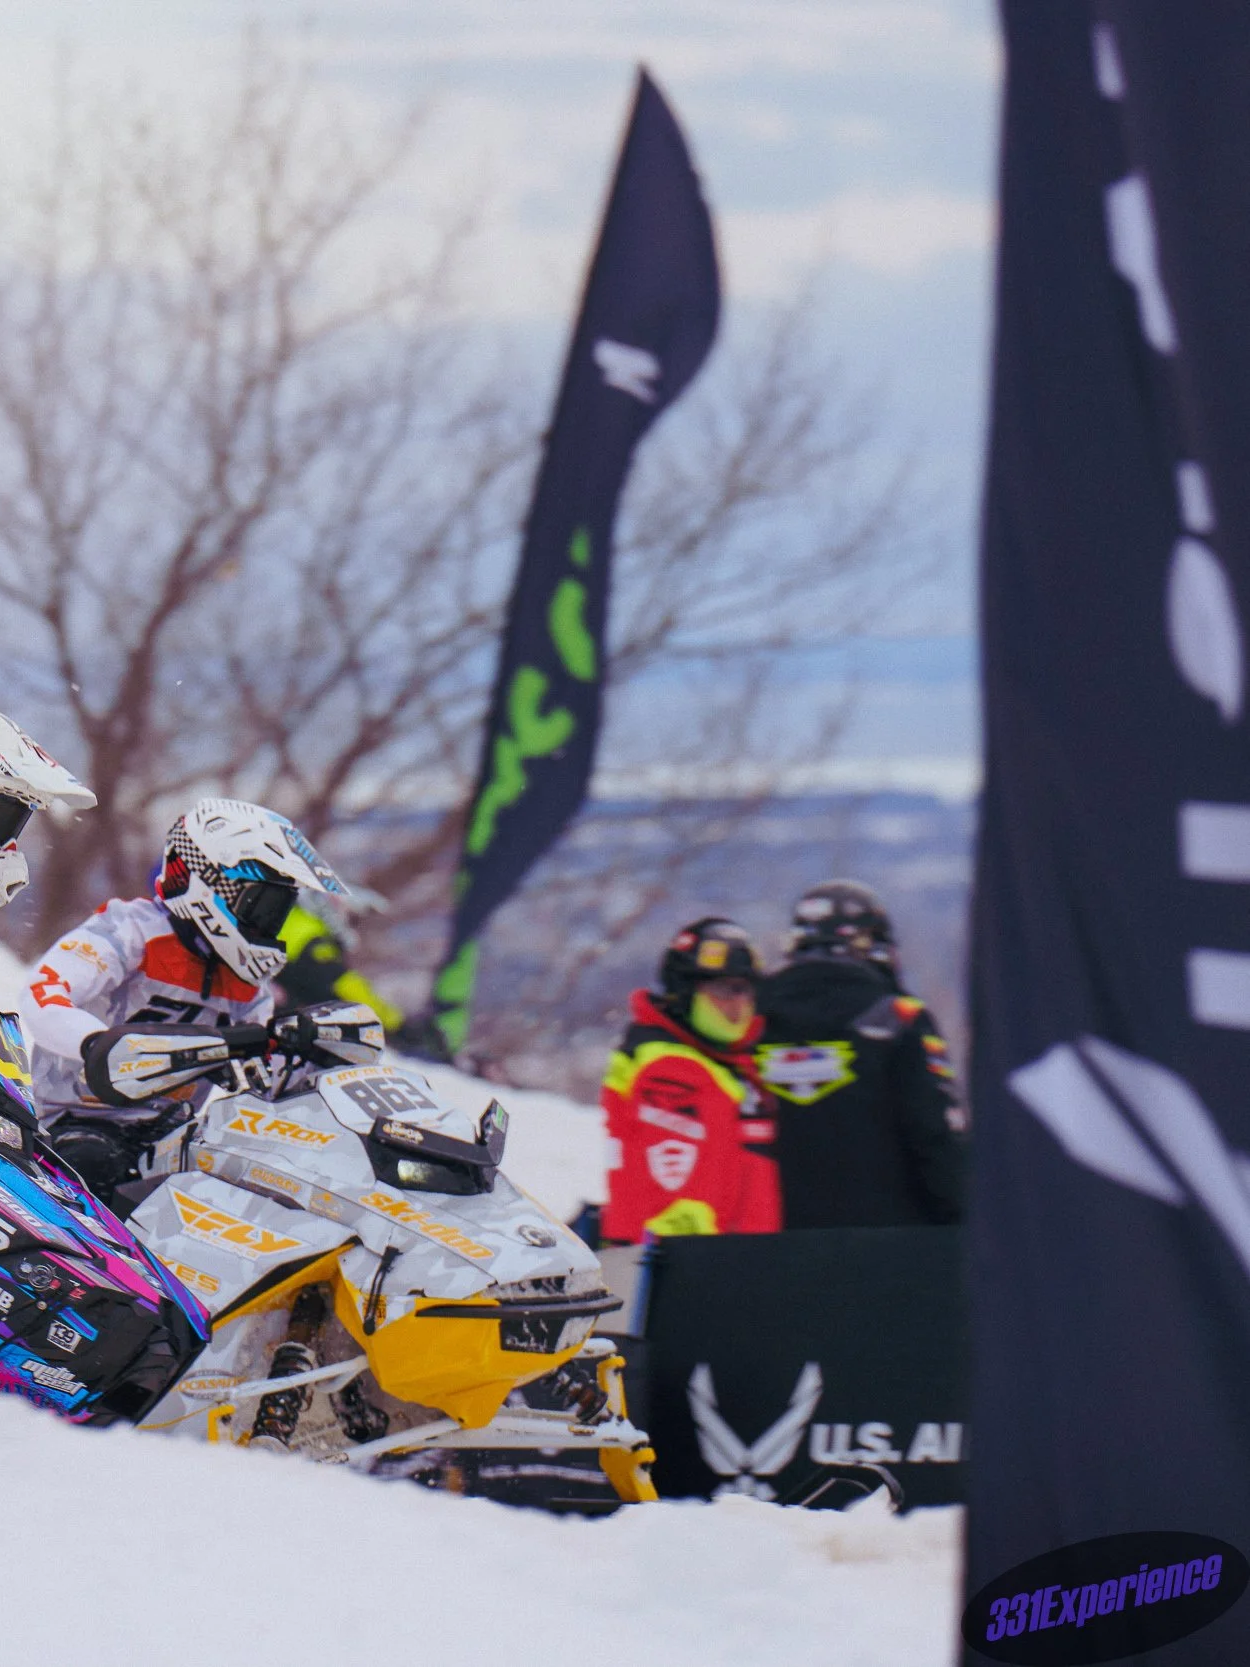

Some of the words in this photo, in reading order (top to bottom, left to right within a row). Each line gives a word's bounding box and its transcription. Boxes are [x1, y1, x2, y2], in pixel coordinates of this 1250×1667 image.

[190, 900, 230, 938] FLY
[340, 1076, 439, 1121] 863
[263, 1119, 337, 1145] ROX
[174, 1190, 302, 1253] FLY
[53, 1322, 76, 1344] 139
